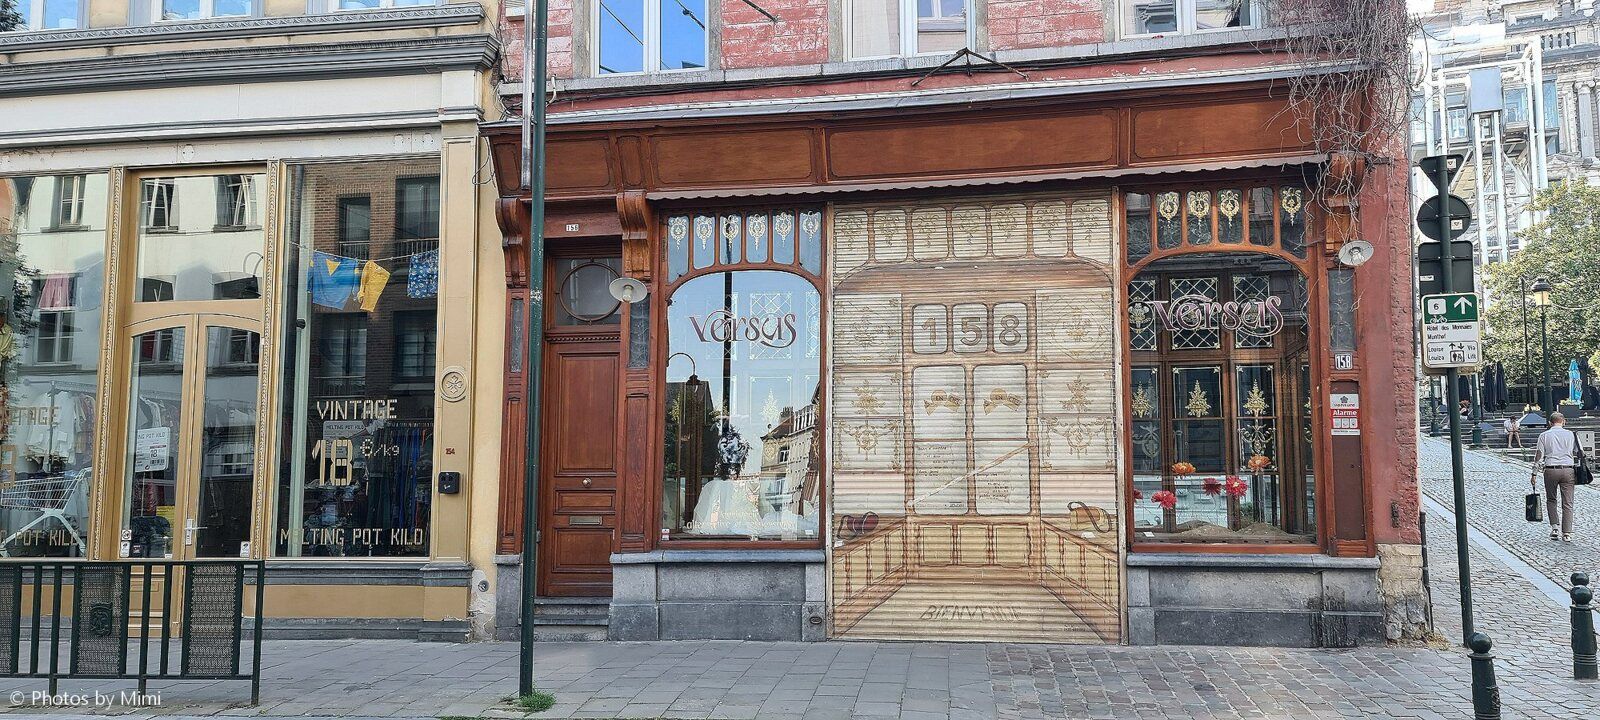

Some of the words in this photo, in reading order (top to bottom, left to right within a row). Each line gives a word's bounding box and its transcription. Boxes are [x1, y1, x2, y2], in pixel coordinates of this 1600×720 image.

[1336, 355, 1351, 369] 158
[316, 399, 398, 420] VINTAGE
[312, 439, 353, 486] 18
[280, 528, 345, 546] MELTING
[352, 528, 383, 546] POT
[390, 528, 423, 546] KILO
